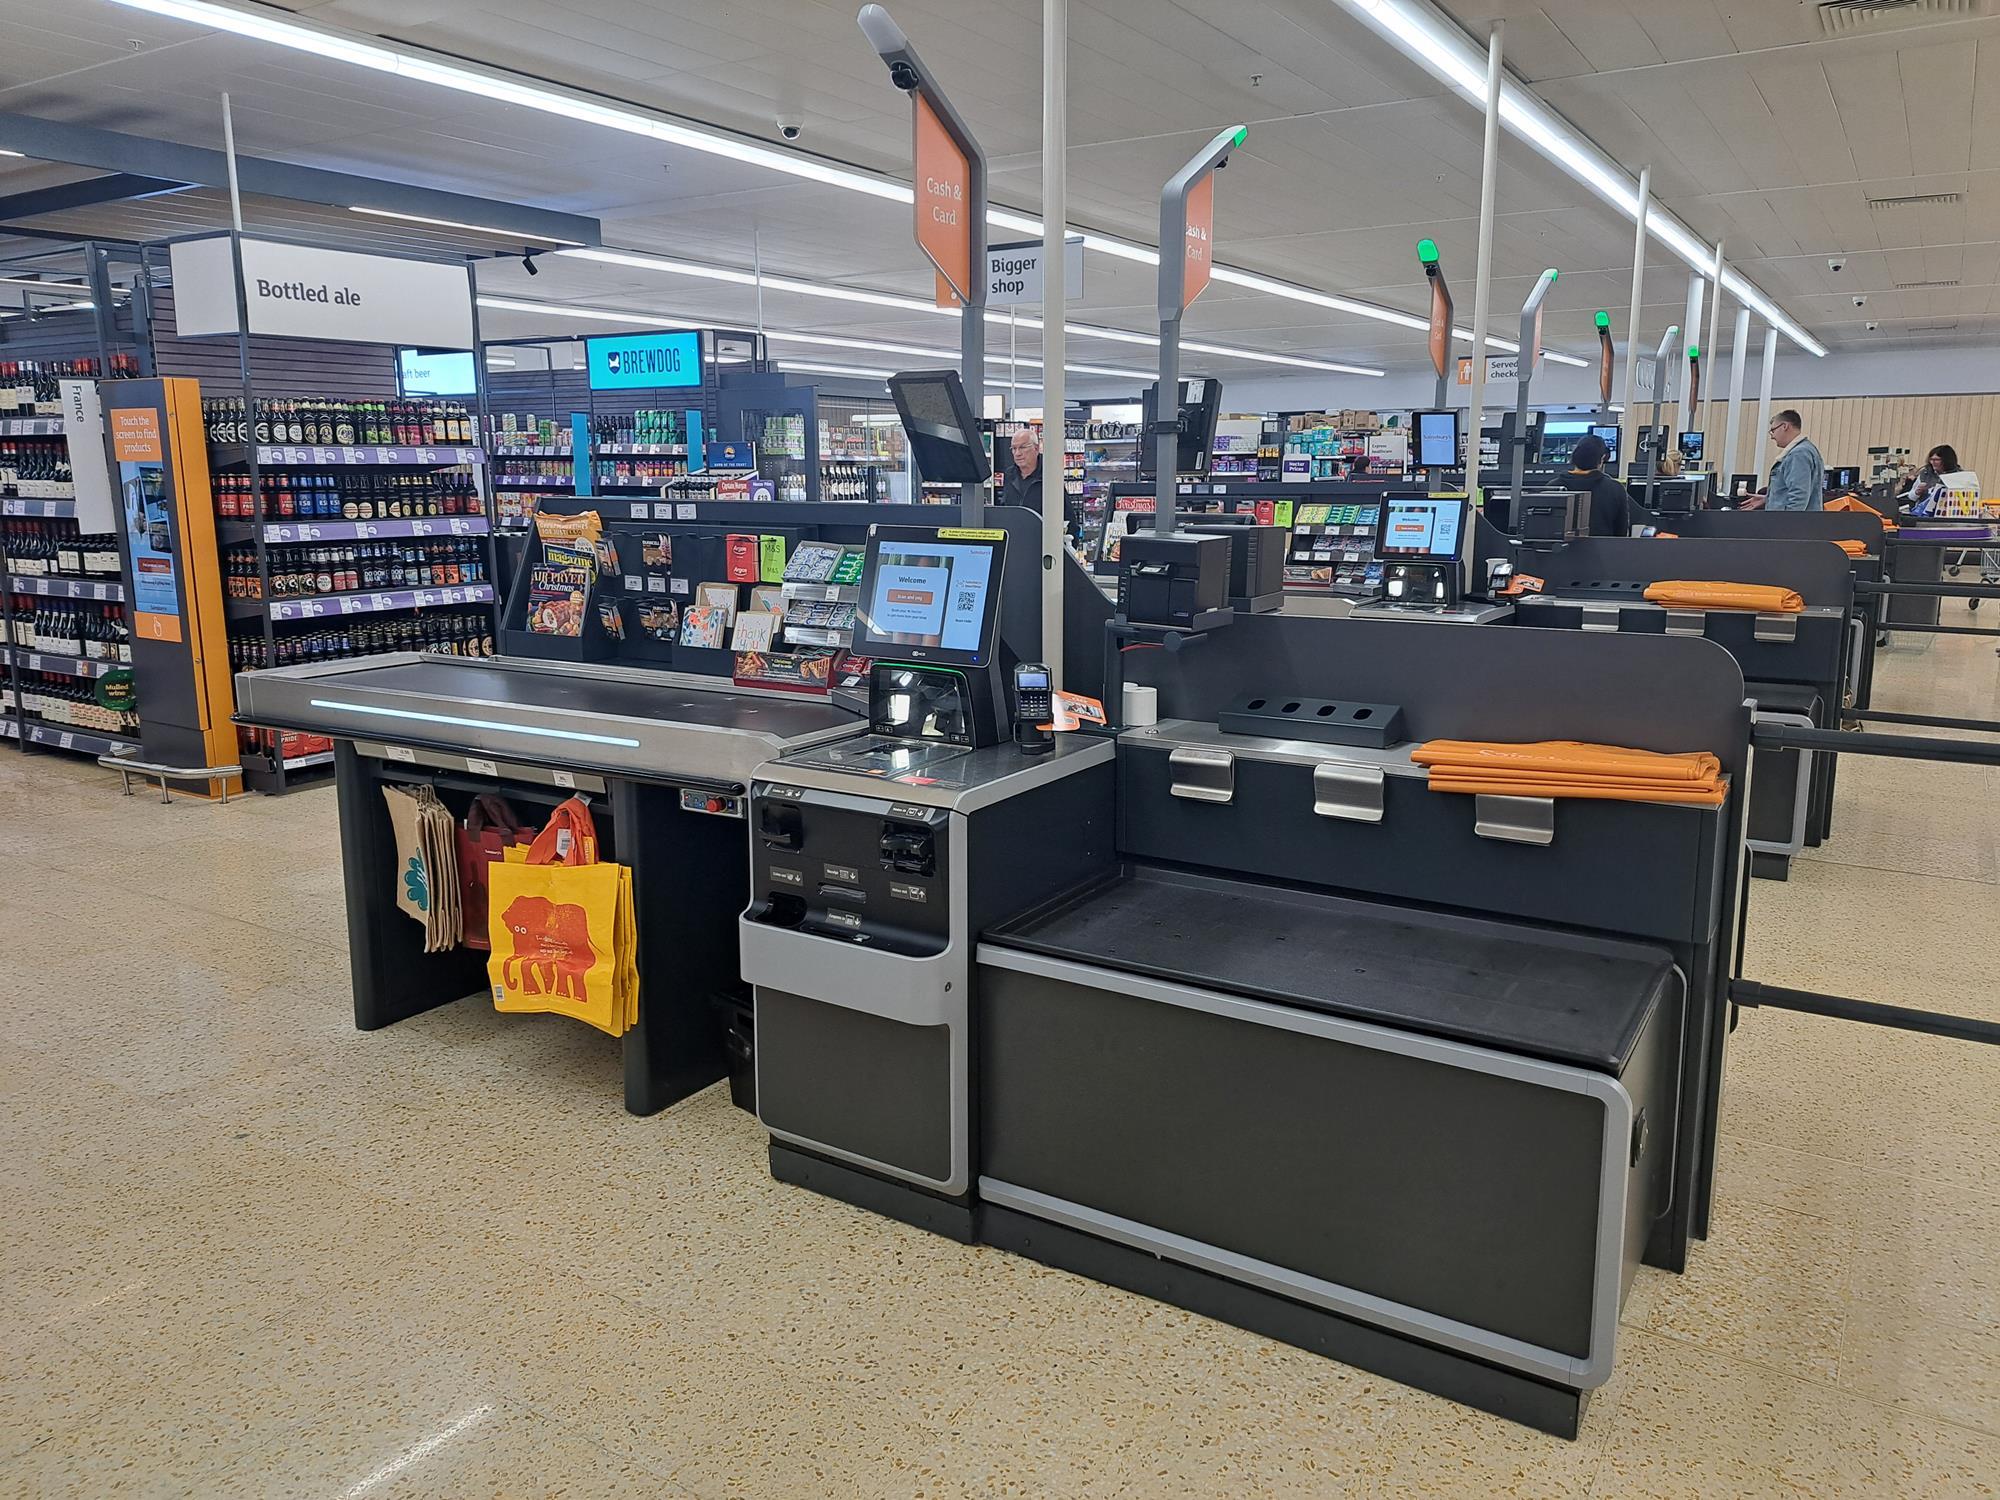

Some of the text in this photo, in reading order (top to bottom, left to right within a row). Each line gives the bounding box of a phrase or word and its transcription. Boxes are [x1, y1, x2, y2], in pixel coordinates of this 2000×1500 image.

[926, 177, 962, 200] Cash &
[932, 206, 956, 225] Card
[1200, 227, 1207, 241] &
[1187, 244, 1203, 261] Card
[991, 258, 1037, 276] Bigger
[256, 279, 361, 306] Bottled ale
[991, 279, 1024, 295] shop
[623, 348, 681, 374] BREWDOG
[1491, 360, 1518, 369] Served
[72, 385, 85, 423] France
[119, 415, 150, 426] Touch the
[116, 428, 157, 440] screen to find
[124, 442, 152, 455] products
[765, 544, 781, 553] M&S
[548, 551, 593, 567] magazine
[538, 581, 575, 592] Christmas
[898, 576, 927, 584] Welcome
